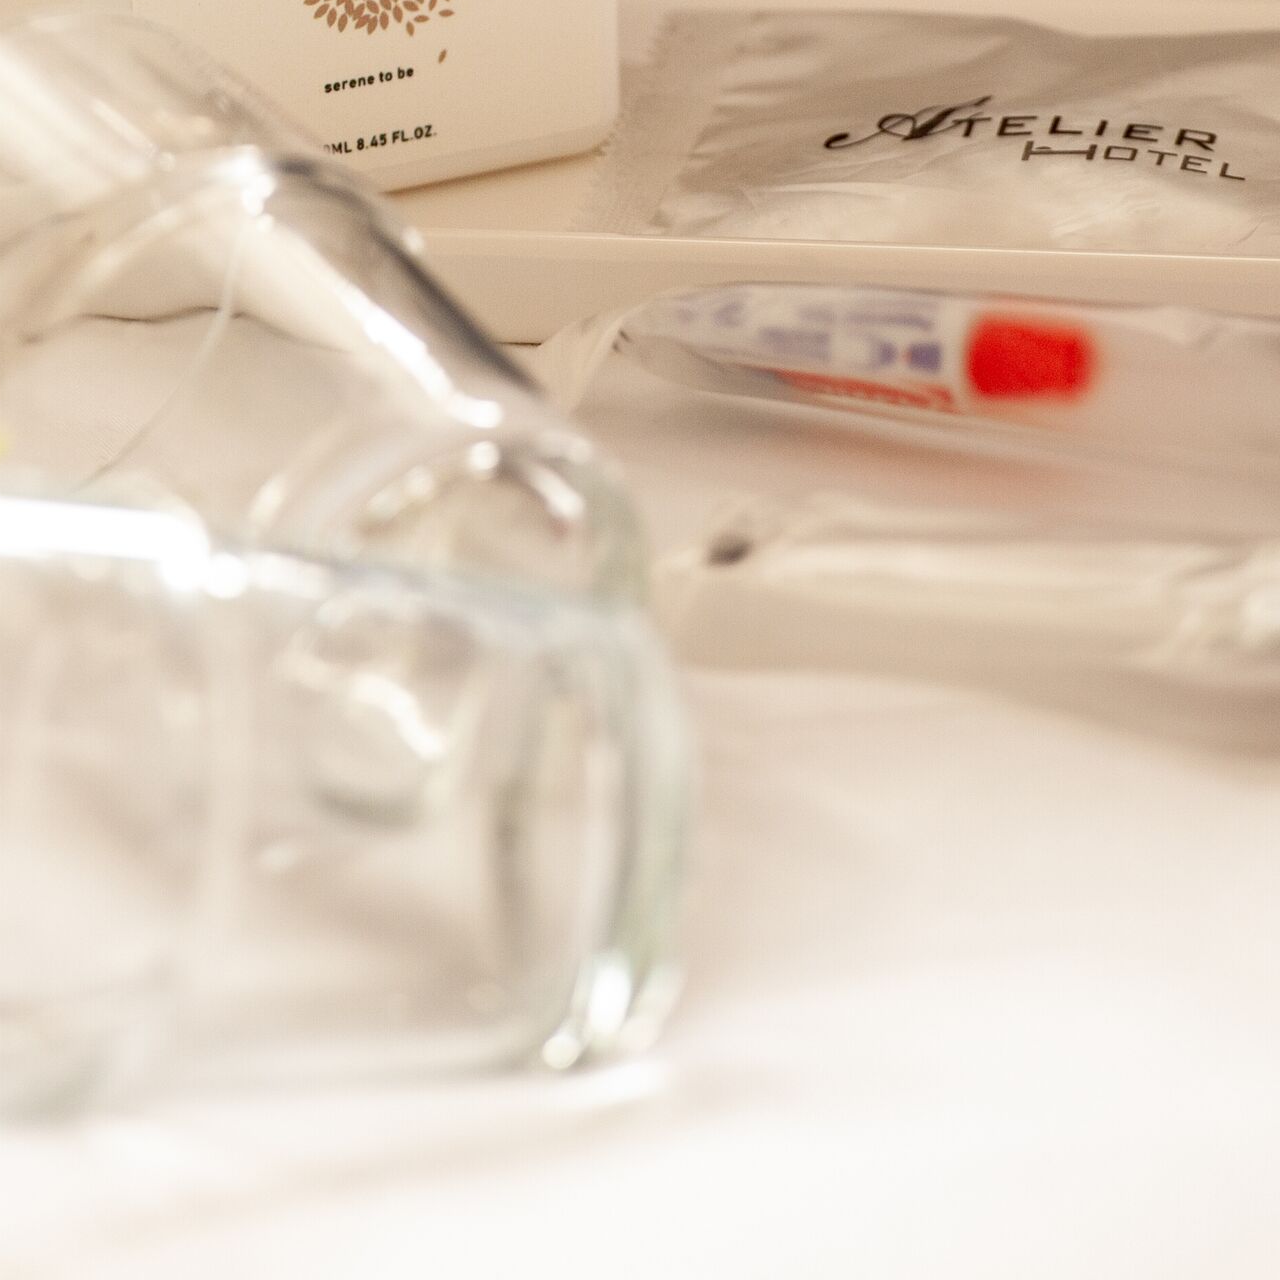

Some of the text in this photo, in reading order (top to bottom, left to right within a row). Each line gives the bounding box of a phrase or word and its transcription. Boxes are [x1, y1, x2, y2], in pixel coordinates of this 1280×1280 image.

[324, 65, 414, 94] serene to be
[823, 95, 1218, 151] ATELIER
[357, 133, 388, 151] 8.45
[1021, 140, 1246, 181] HOTEL
